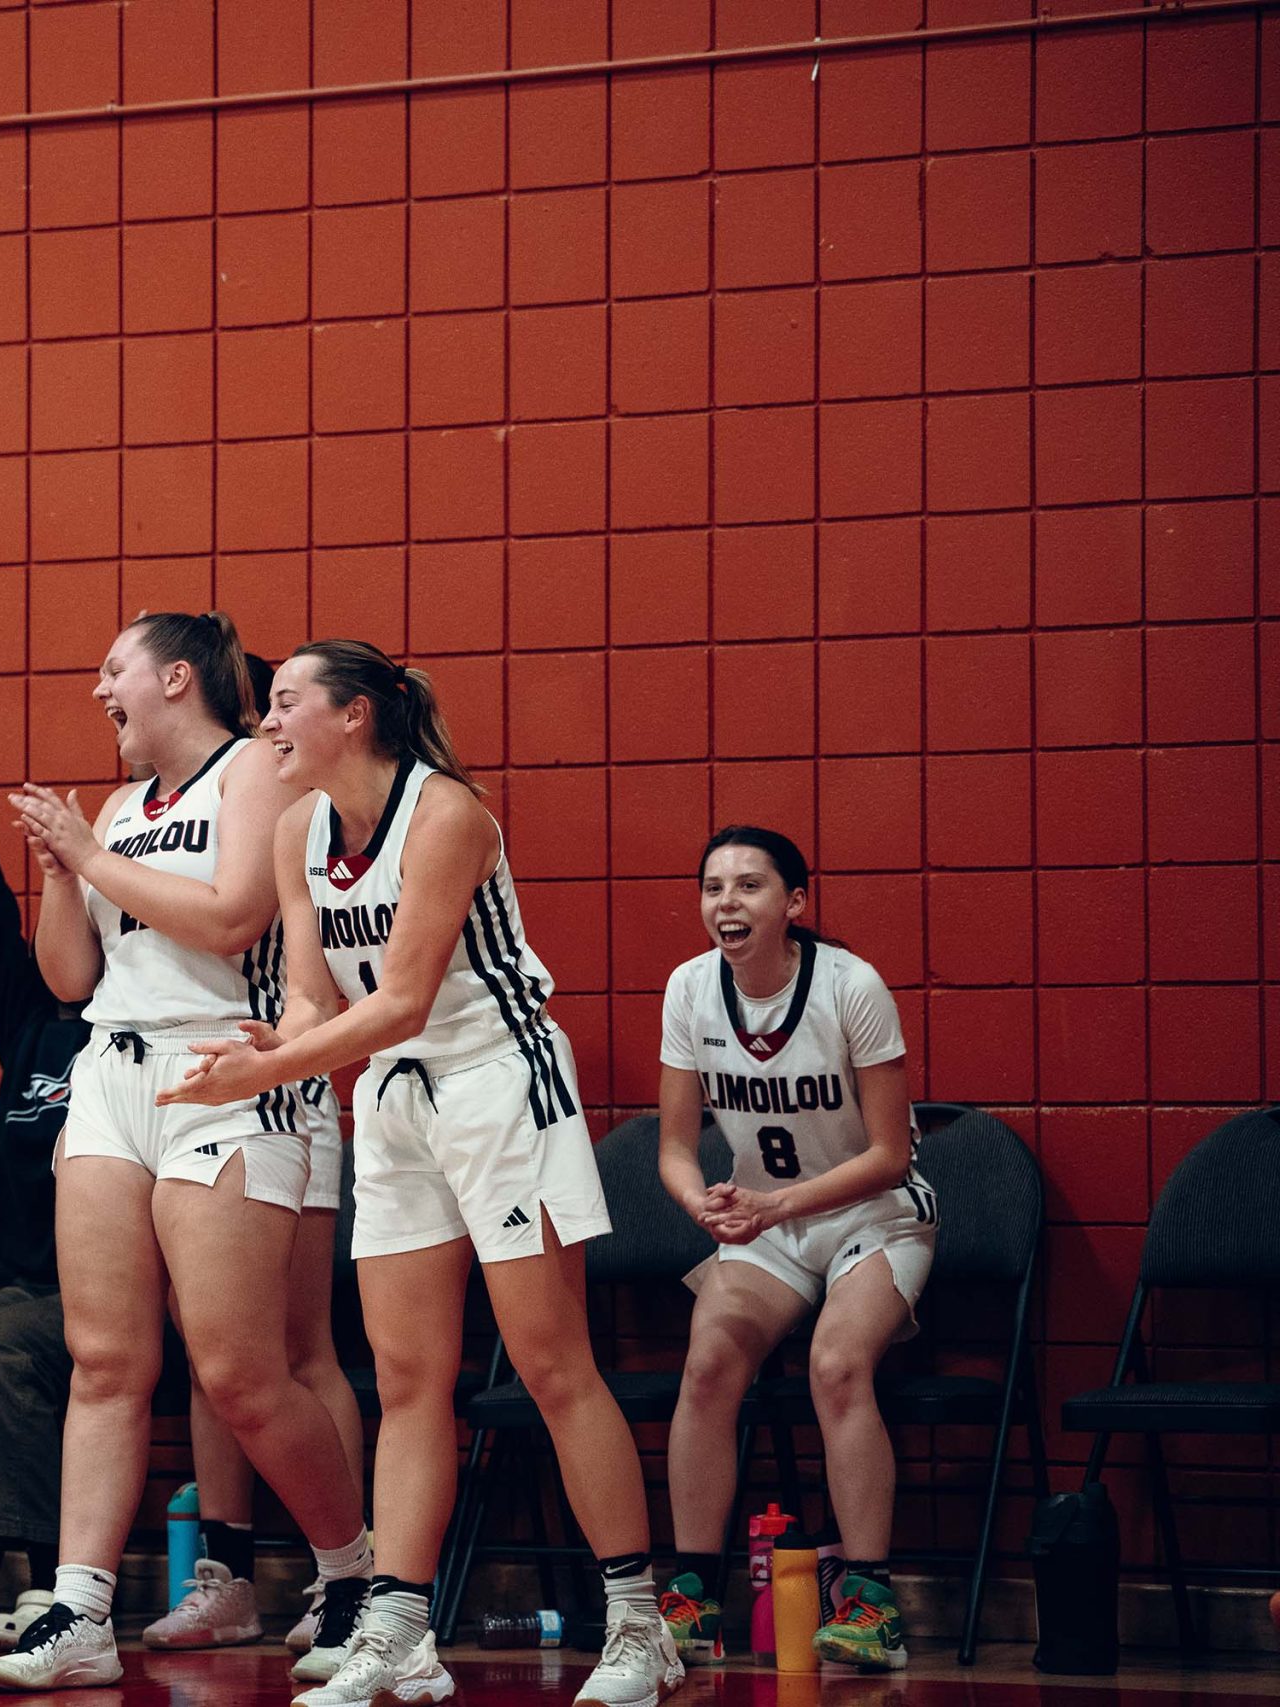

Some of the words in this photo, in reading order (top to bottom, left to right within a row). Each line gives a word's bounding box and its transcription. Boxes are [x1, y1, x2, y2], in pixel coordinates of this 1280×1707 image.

[107, 819, 209, 859] MOILOU
[316, 902, 399, 949] MOILO
[703, 1037, 727, 1047] RSEQ
[702, 1071, 843, 1113] LIMOILOU
[757, 1126, 801, 1178] 8
